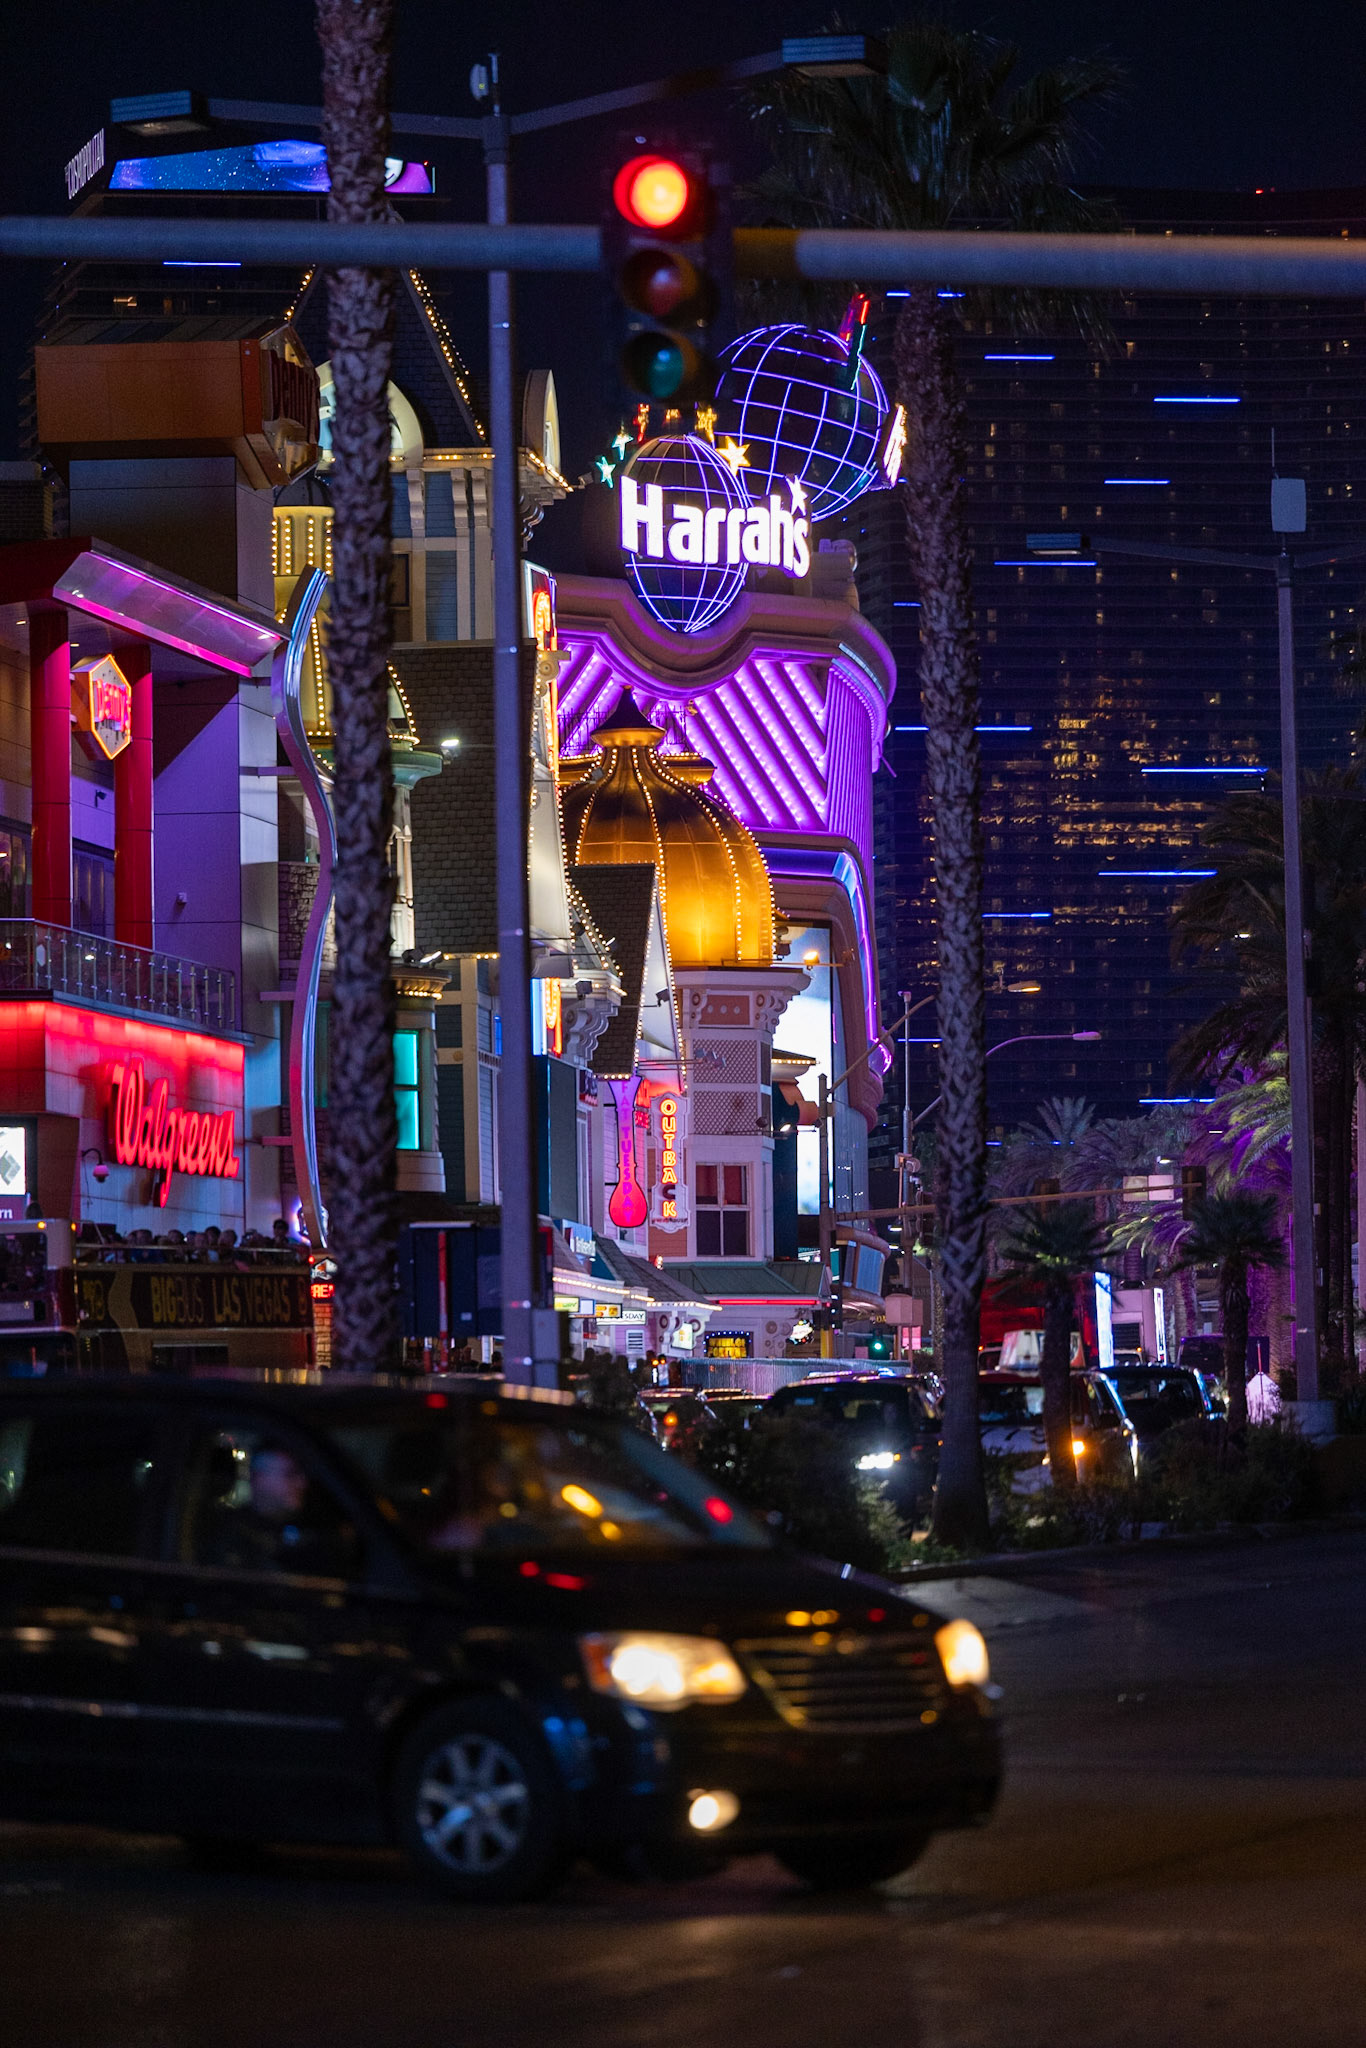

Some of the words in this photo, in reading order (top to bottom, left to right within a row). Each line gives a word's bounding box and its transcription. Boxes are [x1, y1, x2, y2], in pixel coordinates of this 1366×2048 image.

[109, 1061, 240, 1208] Walgreens
[621, 1126, 633, 1224] TUESDAY
[659, 1098, 678, 1218] OUTBACK
[212, 1277, 242, 1323] LAS
[244, 1277, 292, 1323] VEGAS
